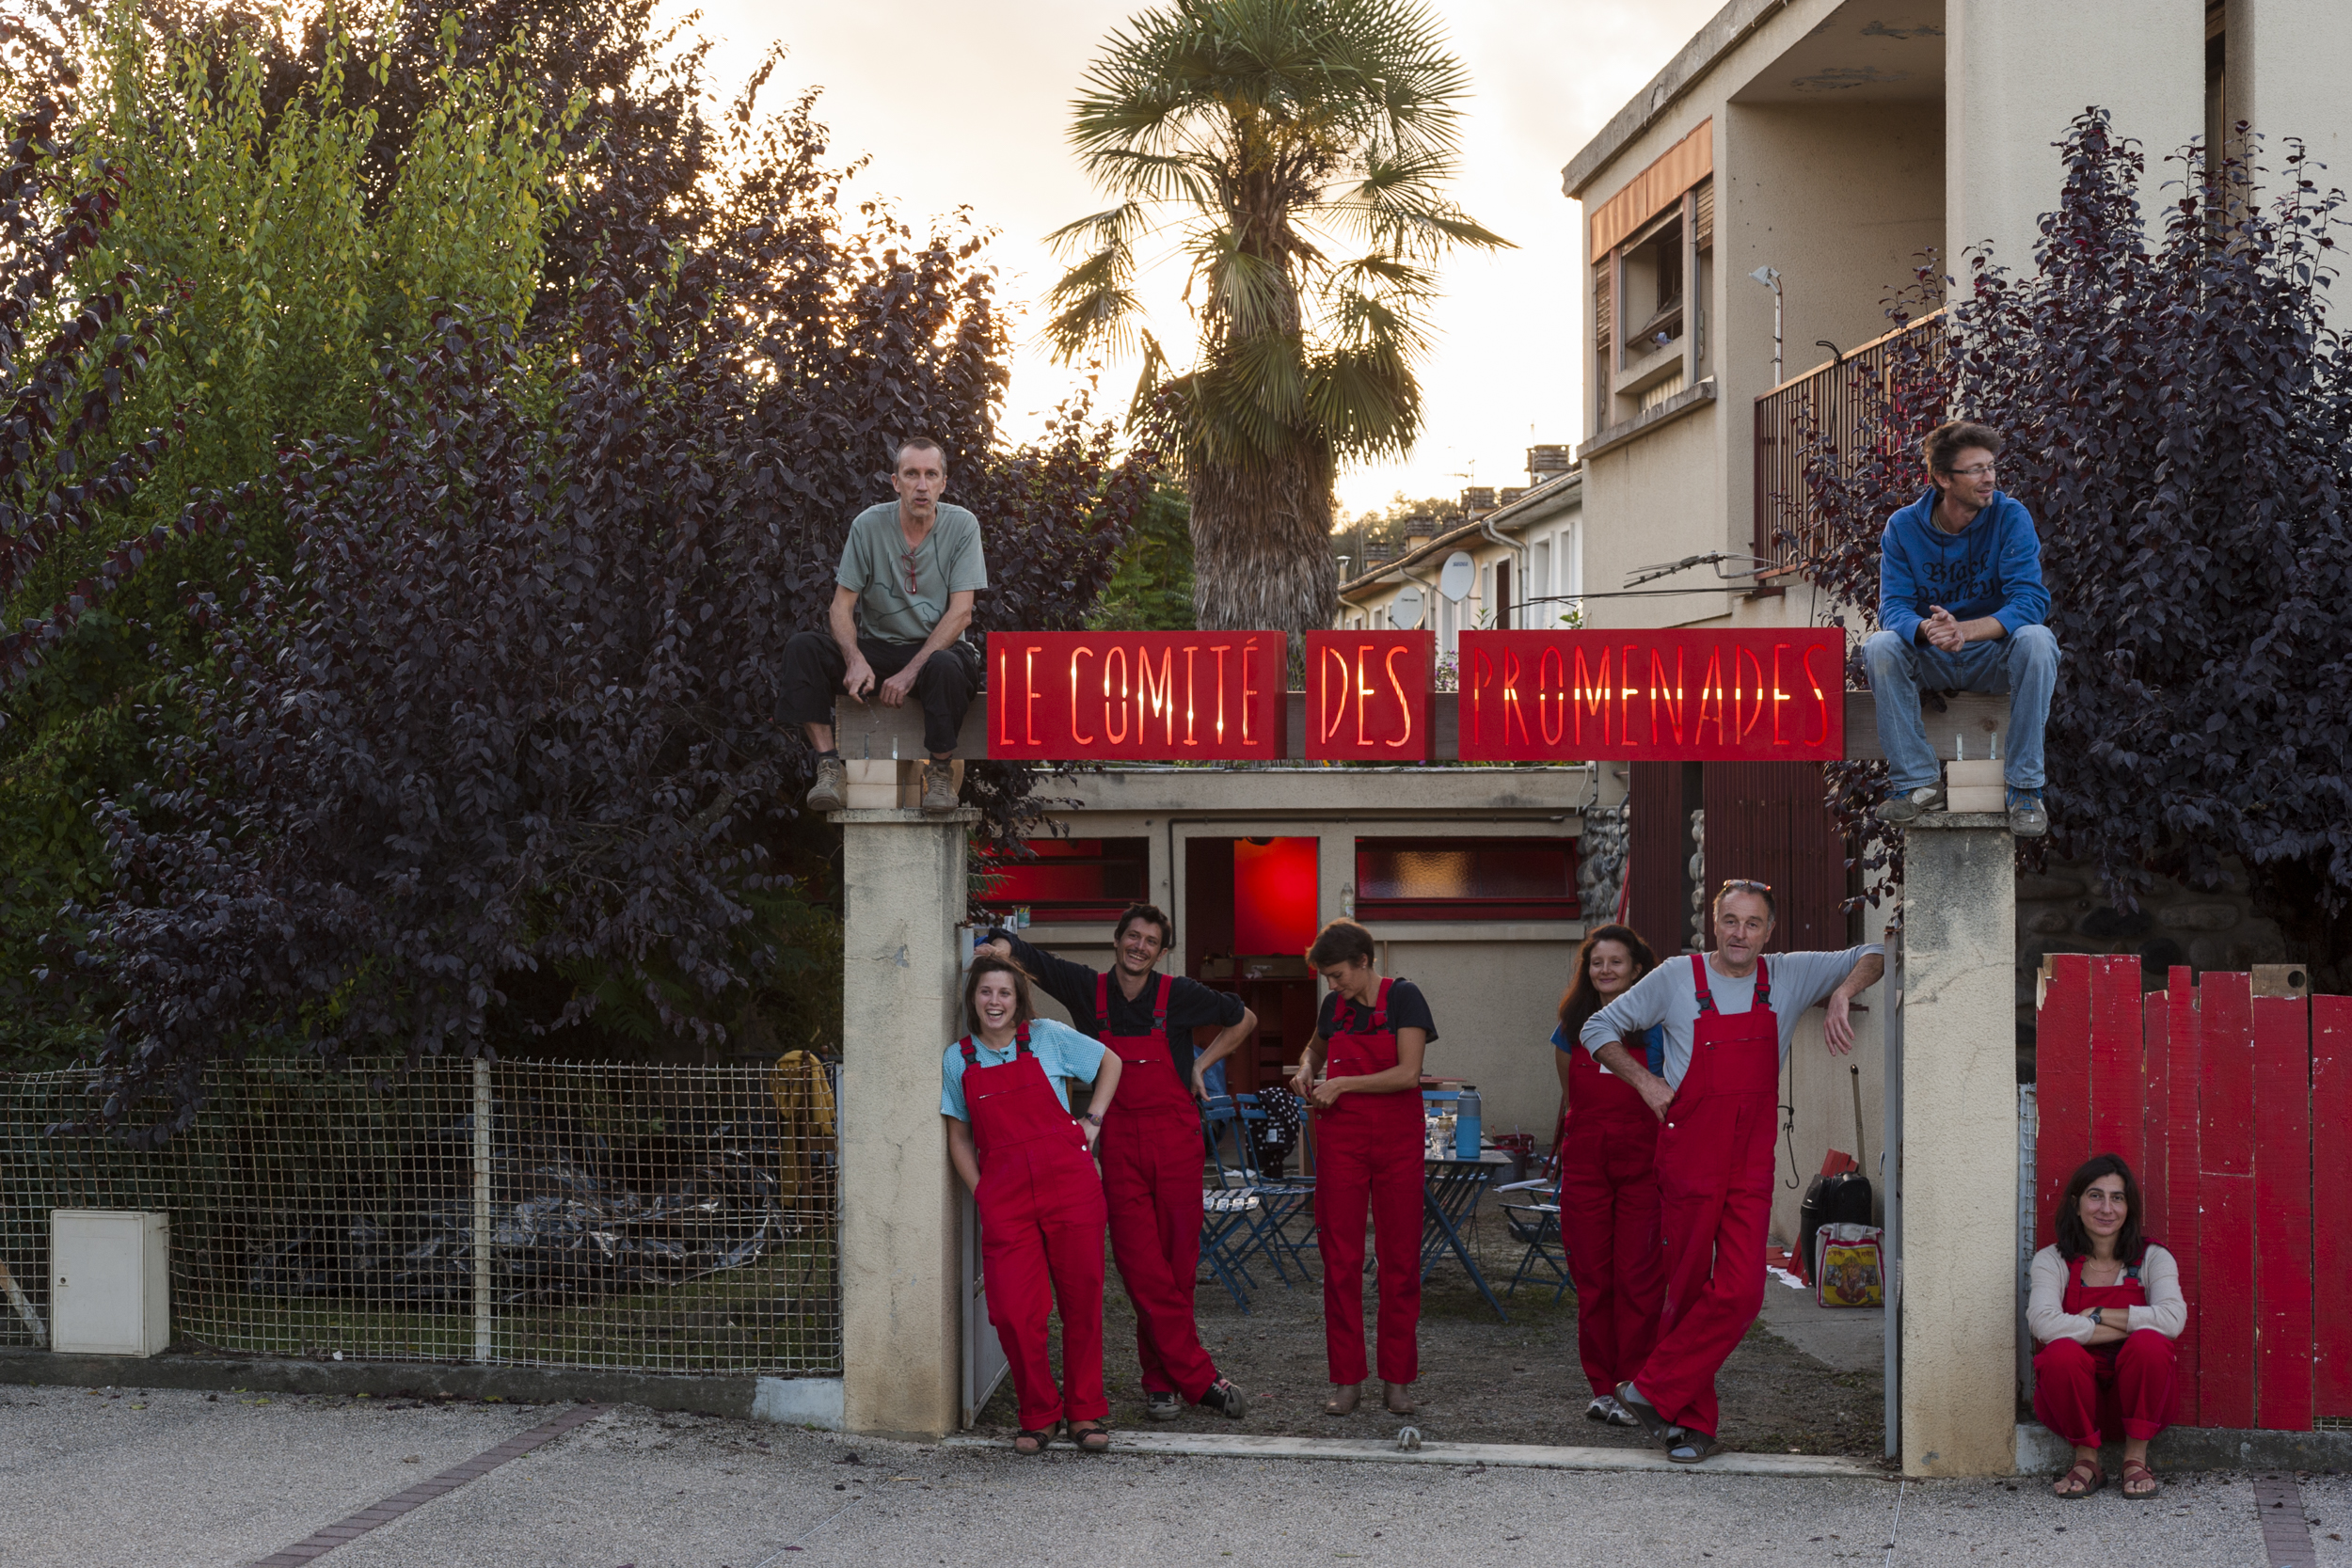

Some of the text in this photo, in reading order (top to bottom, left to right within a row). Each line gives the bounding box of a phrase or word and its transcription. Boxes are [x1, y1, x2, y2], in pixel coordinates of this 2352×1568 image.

[1922, 549, 1991, 584] Black
[1914, 578, 1996, 605] Valley
[999, 636, 1829, 748] LE COMITÉ DES PROMENADES
